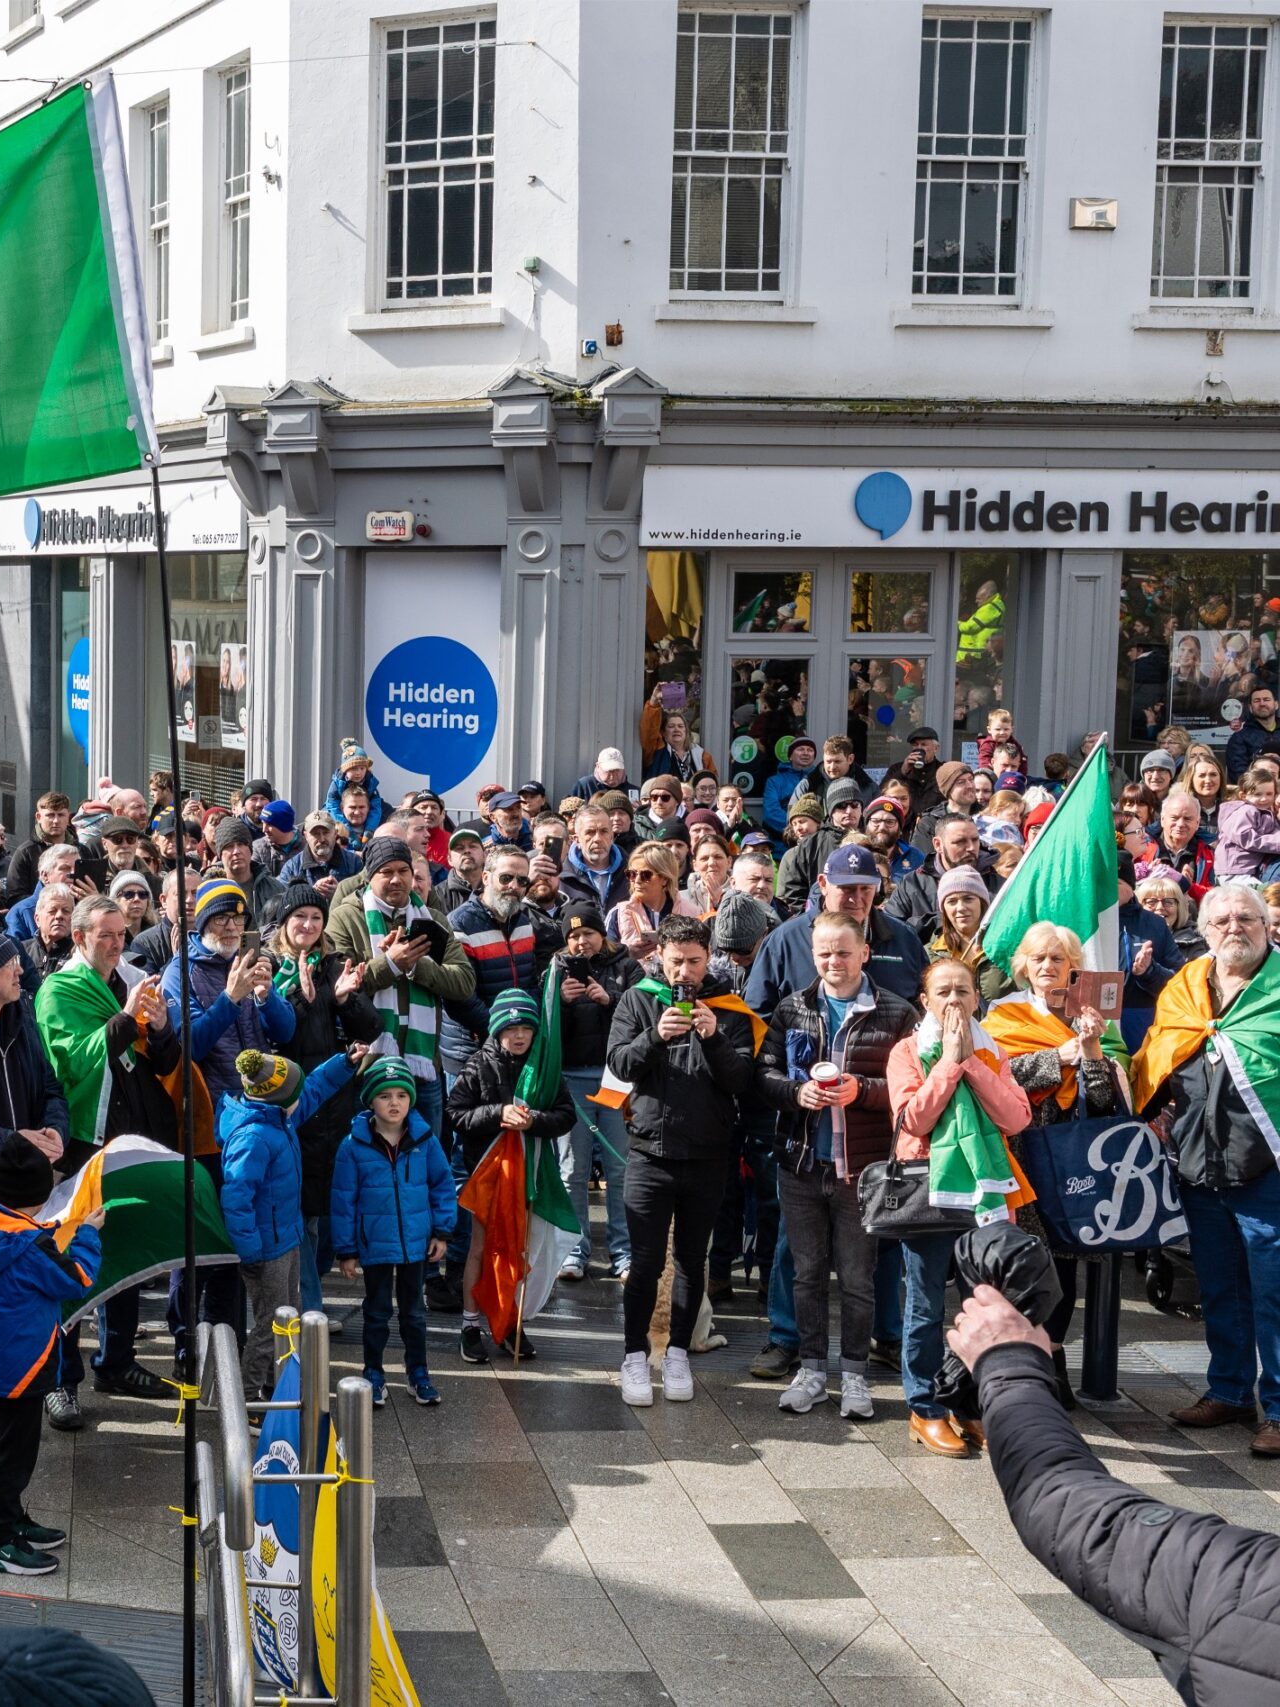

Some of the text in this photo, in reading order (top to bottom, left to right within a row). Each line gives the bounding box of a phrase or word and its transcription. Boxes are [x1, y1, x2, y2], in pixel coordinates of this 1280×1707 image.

[922, 487, 1110, 532] Hidden
[41, 508, 97, 546] Hidden
[370, 516, 406, 528] ComWatch
[648, 528, 802, 543] www.hiddenhearing.ie
[388, 681, 475, 704] Hidden
[383, 707, 479, 735] Hearing
[1065, 1175, 1096, 1195] Boots
